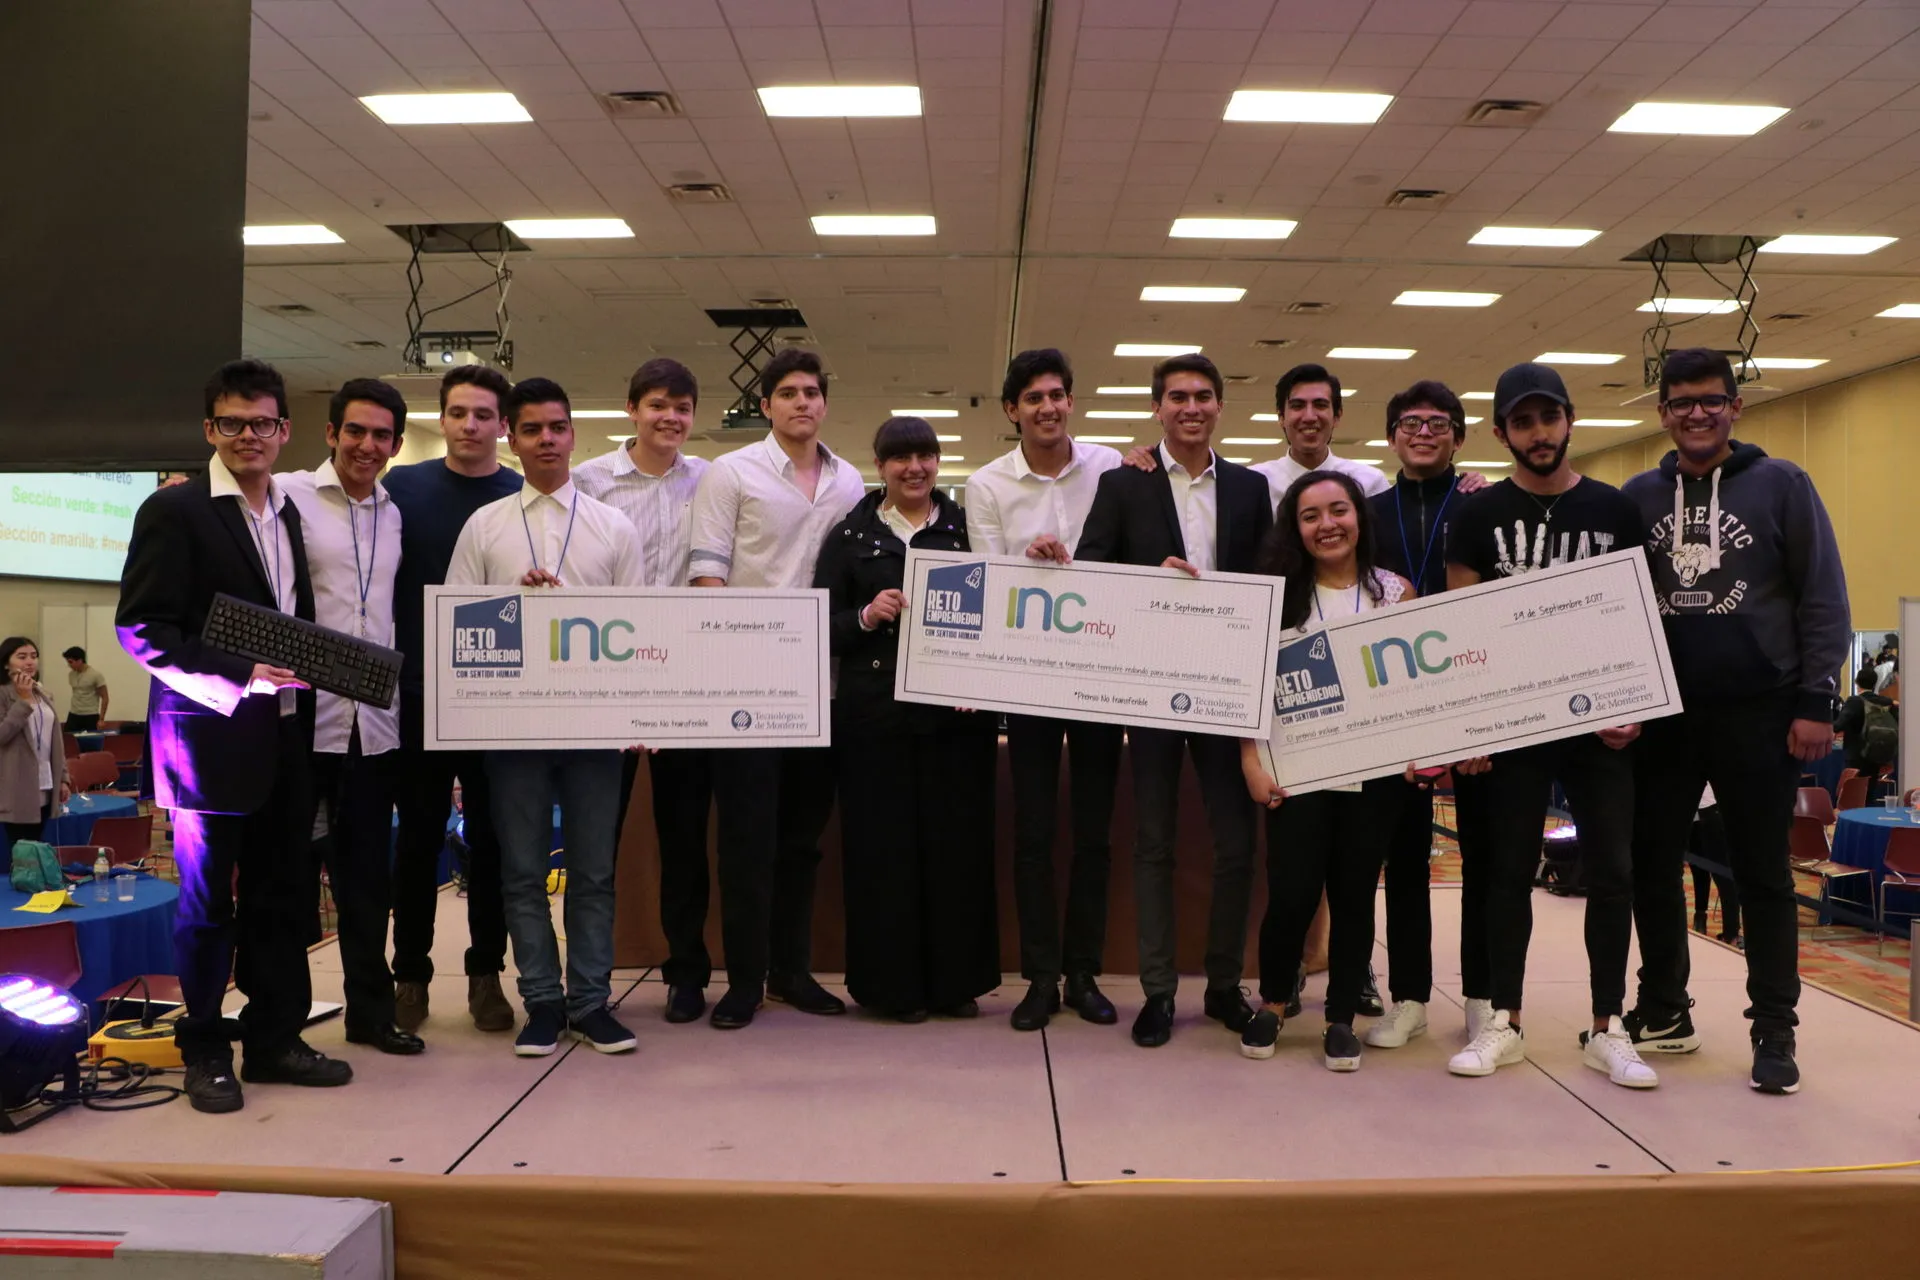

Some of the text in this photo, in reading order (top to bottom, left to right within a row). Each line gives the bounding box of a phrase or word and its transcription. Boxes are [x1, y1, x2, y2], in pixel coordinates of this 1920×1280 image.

[12, 485, 61, 508] Sección
[65, 497, 98, 514] verde:
[50, 531, 98, 549] amarilla:
[927, 590, 960, 610] RETO
[1526, 607, 1536, 618] de
[1538, 595, 1582, 618] Septiembre
[1584, 591, 1603, 604] 2017
[1674, 593, 1708, 605] PUMA
[1161, 601, 1171, 611] de
[1173, 602, 1214, 616] Septiembre
[1217, 606, 1234, 616] 2017
[926, 610, 980, 625] EMPRENDEDOR
[713, 620, 721, 629] de
[724, 620, 764, 632] Septiembre
[768, 621, 785, 630] 2017
[456, 628, 494, 648] RETO
[924, 628, 979, 640] CON SENTIDO HUMANO
[456, 649, 520, 661] EMPRENDEDOR
[456, 670, 520, 678] CON SENTIDO HUMANO
[1149, 668, 1164, 678] para
[1165, 668, 1179, 678] cada
[1278, 683, 1339, 709] EMPRENDEDOR
[1346, 716, 1370, 730] entrada
[1372, 714, 1377, 724] al
[1405, 701, 1436, 718] hospedaje
[1444, 692, 1477, 709] transporte
[1509, 679, 1535, 693] redondo
[1537, 677, 1553, 689] para
[1553, 672, 1569, 684] cada
[1600, 663, 1610, 673] del
[1593, 681, 1647, 703] Tecnológico
[1194, 695, 1244, 710] Tecnológico
[1594, 691, 1654, 711] de Monterrey
[755, 710, 803, 720] Tecnológico
[1192, 705, 1248, 720] de Monterrey
[1281, 702, 1344, 726] CON SENTIDO HUMANO
[1494, 720, 1504, 730] No
[1506, 710, 1546, 728] transferible
[754, 720, 808, 730] de Monterrey
